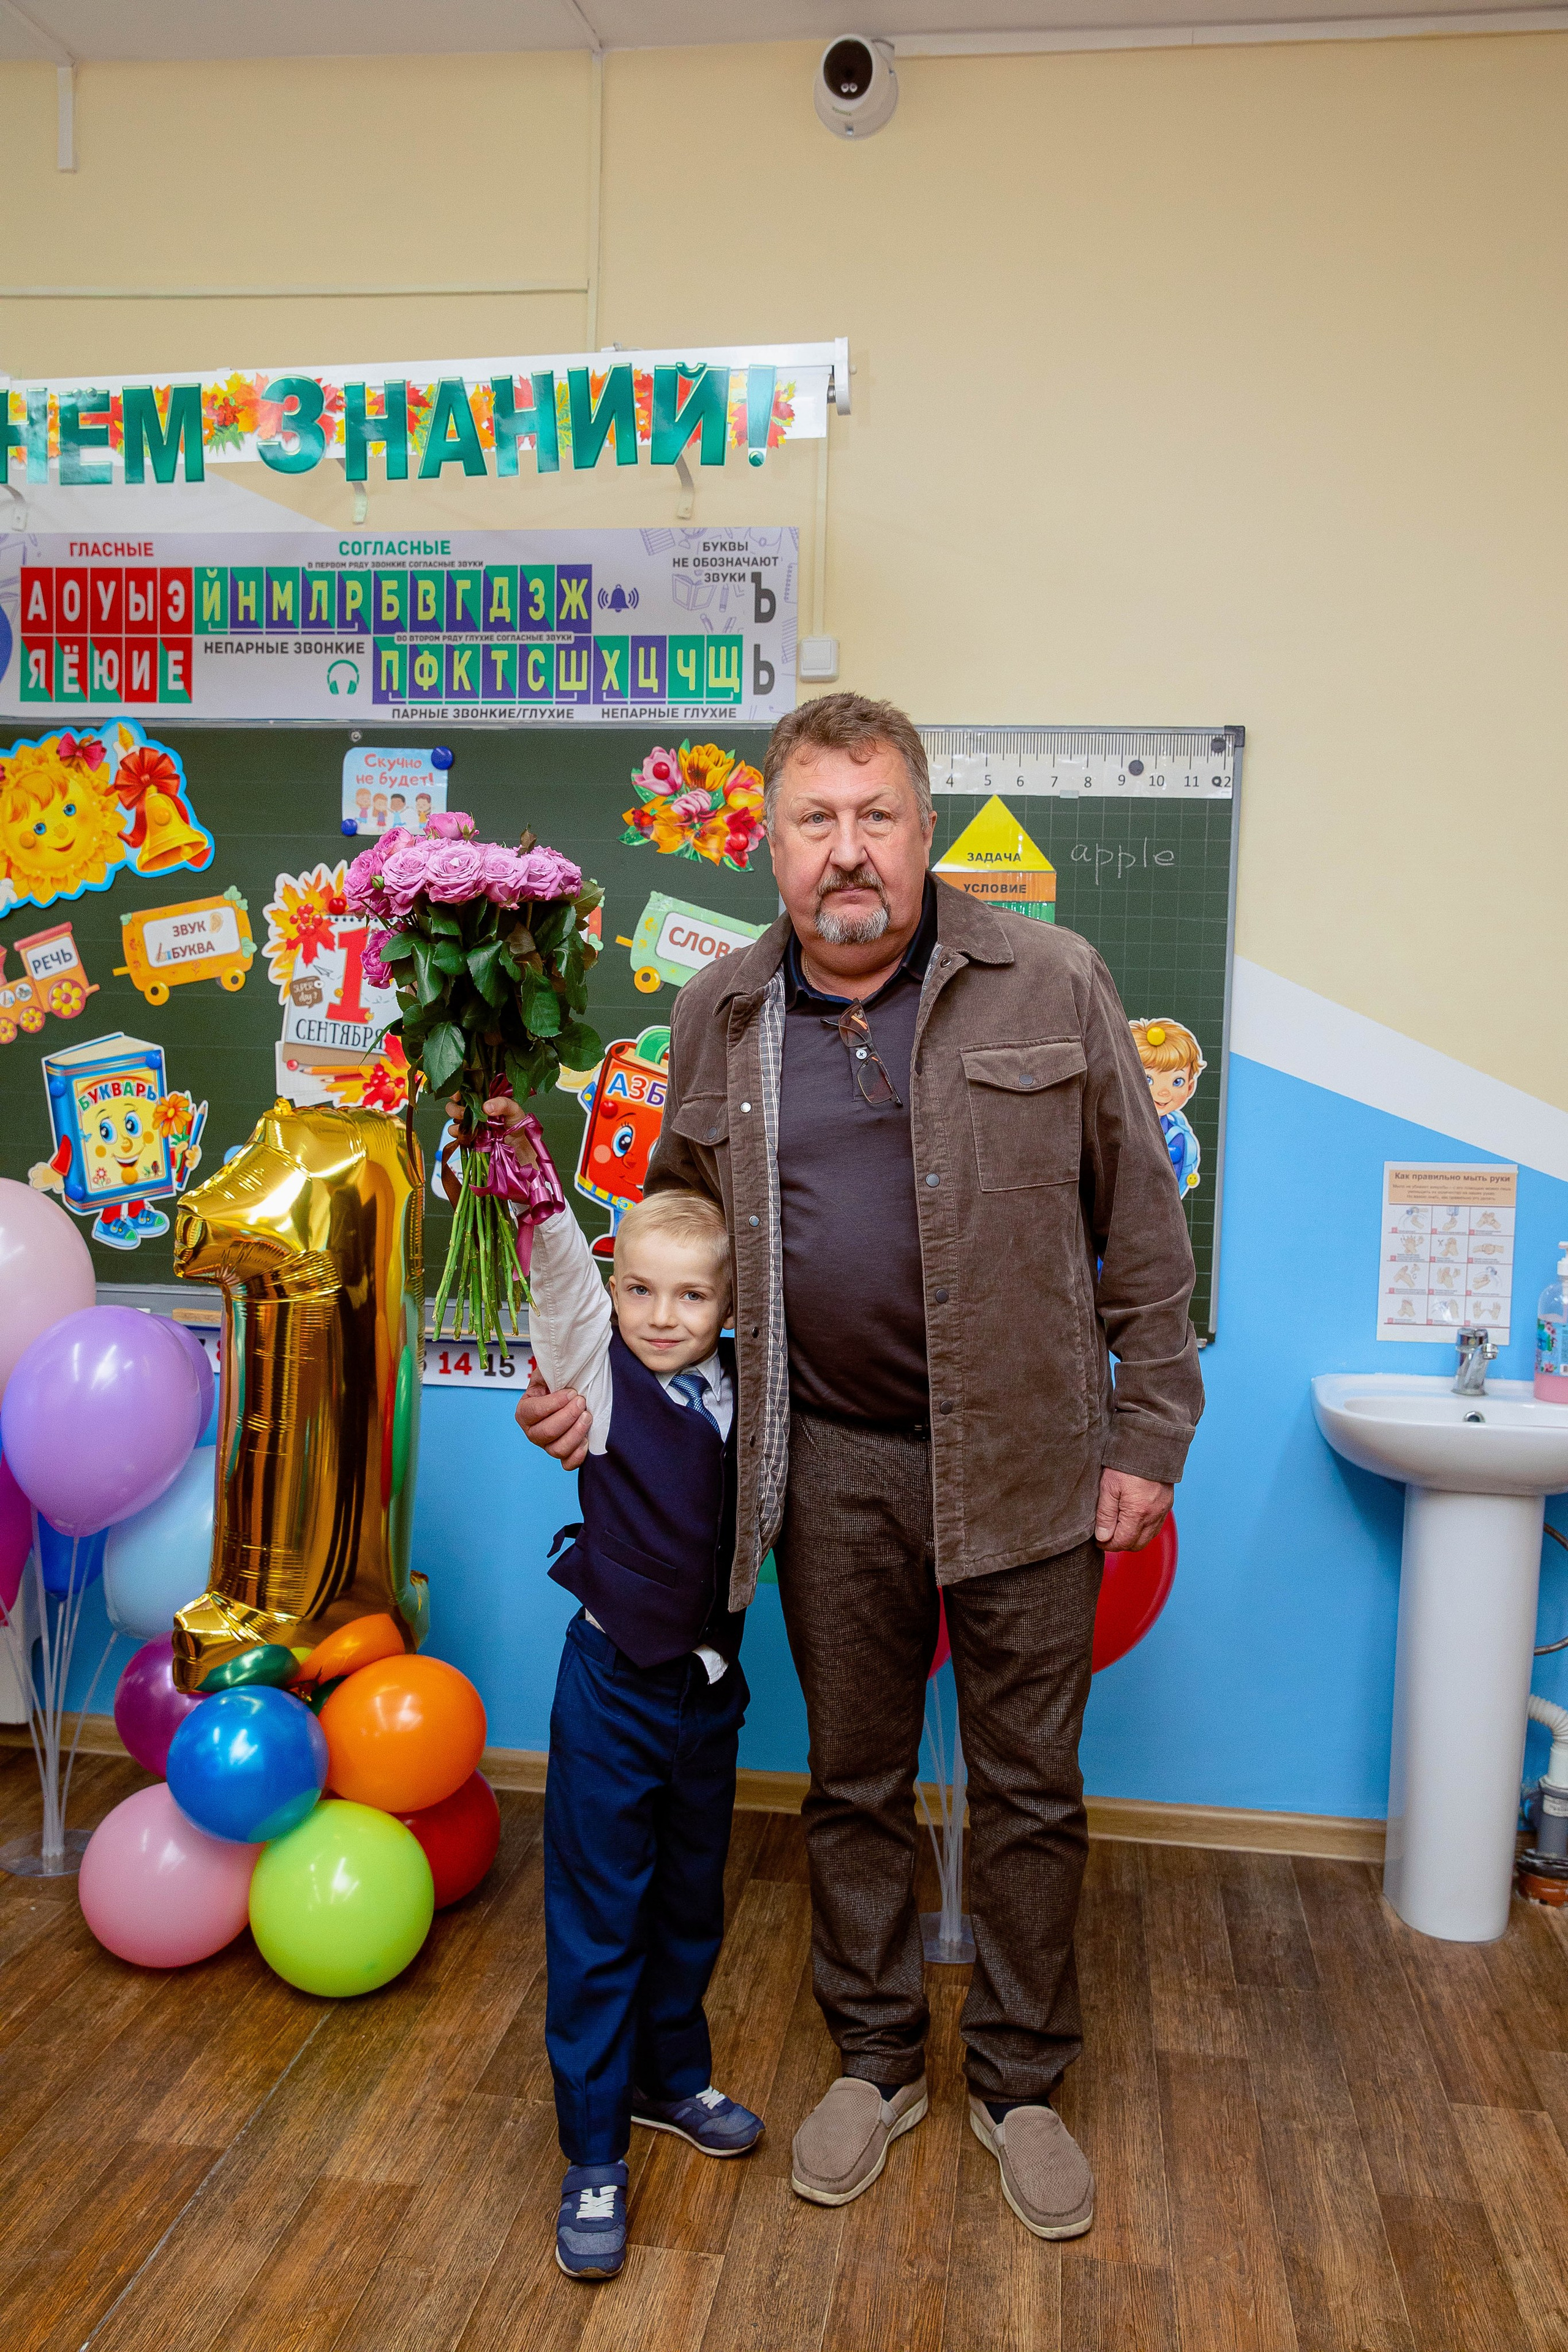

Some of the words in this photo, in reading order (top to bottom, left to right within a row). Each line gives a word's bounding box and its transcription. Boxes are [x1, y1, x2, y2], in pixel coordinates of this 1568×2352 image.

[257, 361, 777, 482] ЗНАНИЙ!
[69, 542, 154, 557] ГЛАСНЫЕ
[339, 540, 451, 556] СОГЛАСНЫЕ
[703, 541, 748, 552] БУКВЫ
[673, 557, 689, 568] НЕ
[693, 557, 778, 568] ОБОЗНАЧАЮТ
[704, 573, 745, 583] ЗВУКИ
[751, 571, 776, 624] Ъ
[204, 641, 288, 654] НЕПАРНЫЕ
[294, 641, 364, 654] ЗВОНКИЕ
[753, 644, 775, 695] Ь
[392, 708, 448, 719] ПАРНЫЕ
[453, 708, 574, 719] ЗВОНКИЕ/ГЛУХИЕ
[601, 708, 679, 719] НЕПАРНЫЕ
[684, 708, 737, 718] ГЛУХИЕ
[364, 753, 423, 772] Скучно
[356, 774, 374, 785] не
[379, 772, 435, 789] будет!
[946, 775, 954, 788] 4
[984, 775, 992, 786] 5
[1017, 775, 1024, 787] 6
[1050, 776, 1058, 788] 7
[1084, 777, 1091, 788] 8
[1118, 775, 1126, 787] 9
[1149, 775, 1164, 787] 10
[1184, 775, 1199, 787] 11
[967, 853, 1022, 863] ЗАДАЧА
[1071, 837, 1175, 886] apple
[963, 883, 1027, 894] УСЛОВИЕ
[172, 920, 206, 938] ЗВУК
[172, 941, 215, 959] БУКВА
[669, 927, 743, 960] СЛОВ
[32, 949, 73, 974] РЕЧЬ
[326, 925, 374, 1024] 1
[77, 1081, 157, 1112] БУКВАРЬ
[439, 1351, 472, 1375] 14
[484, 1353, 516, 1378] 15
